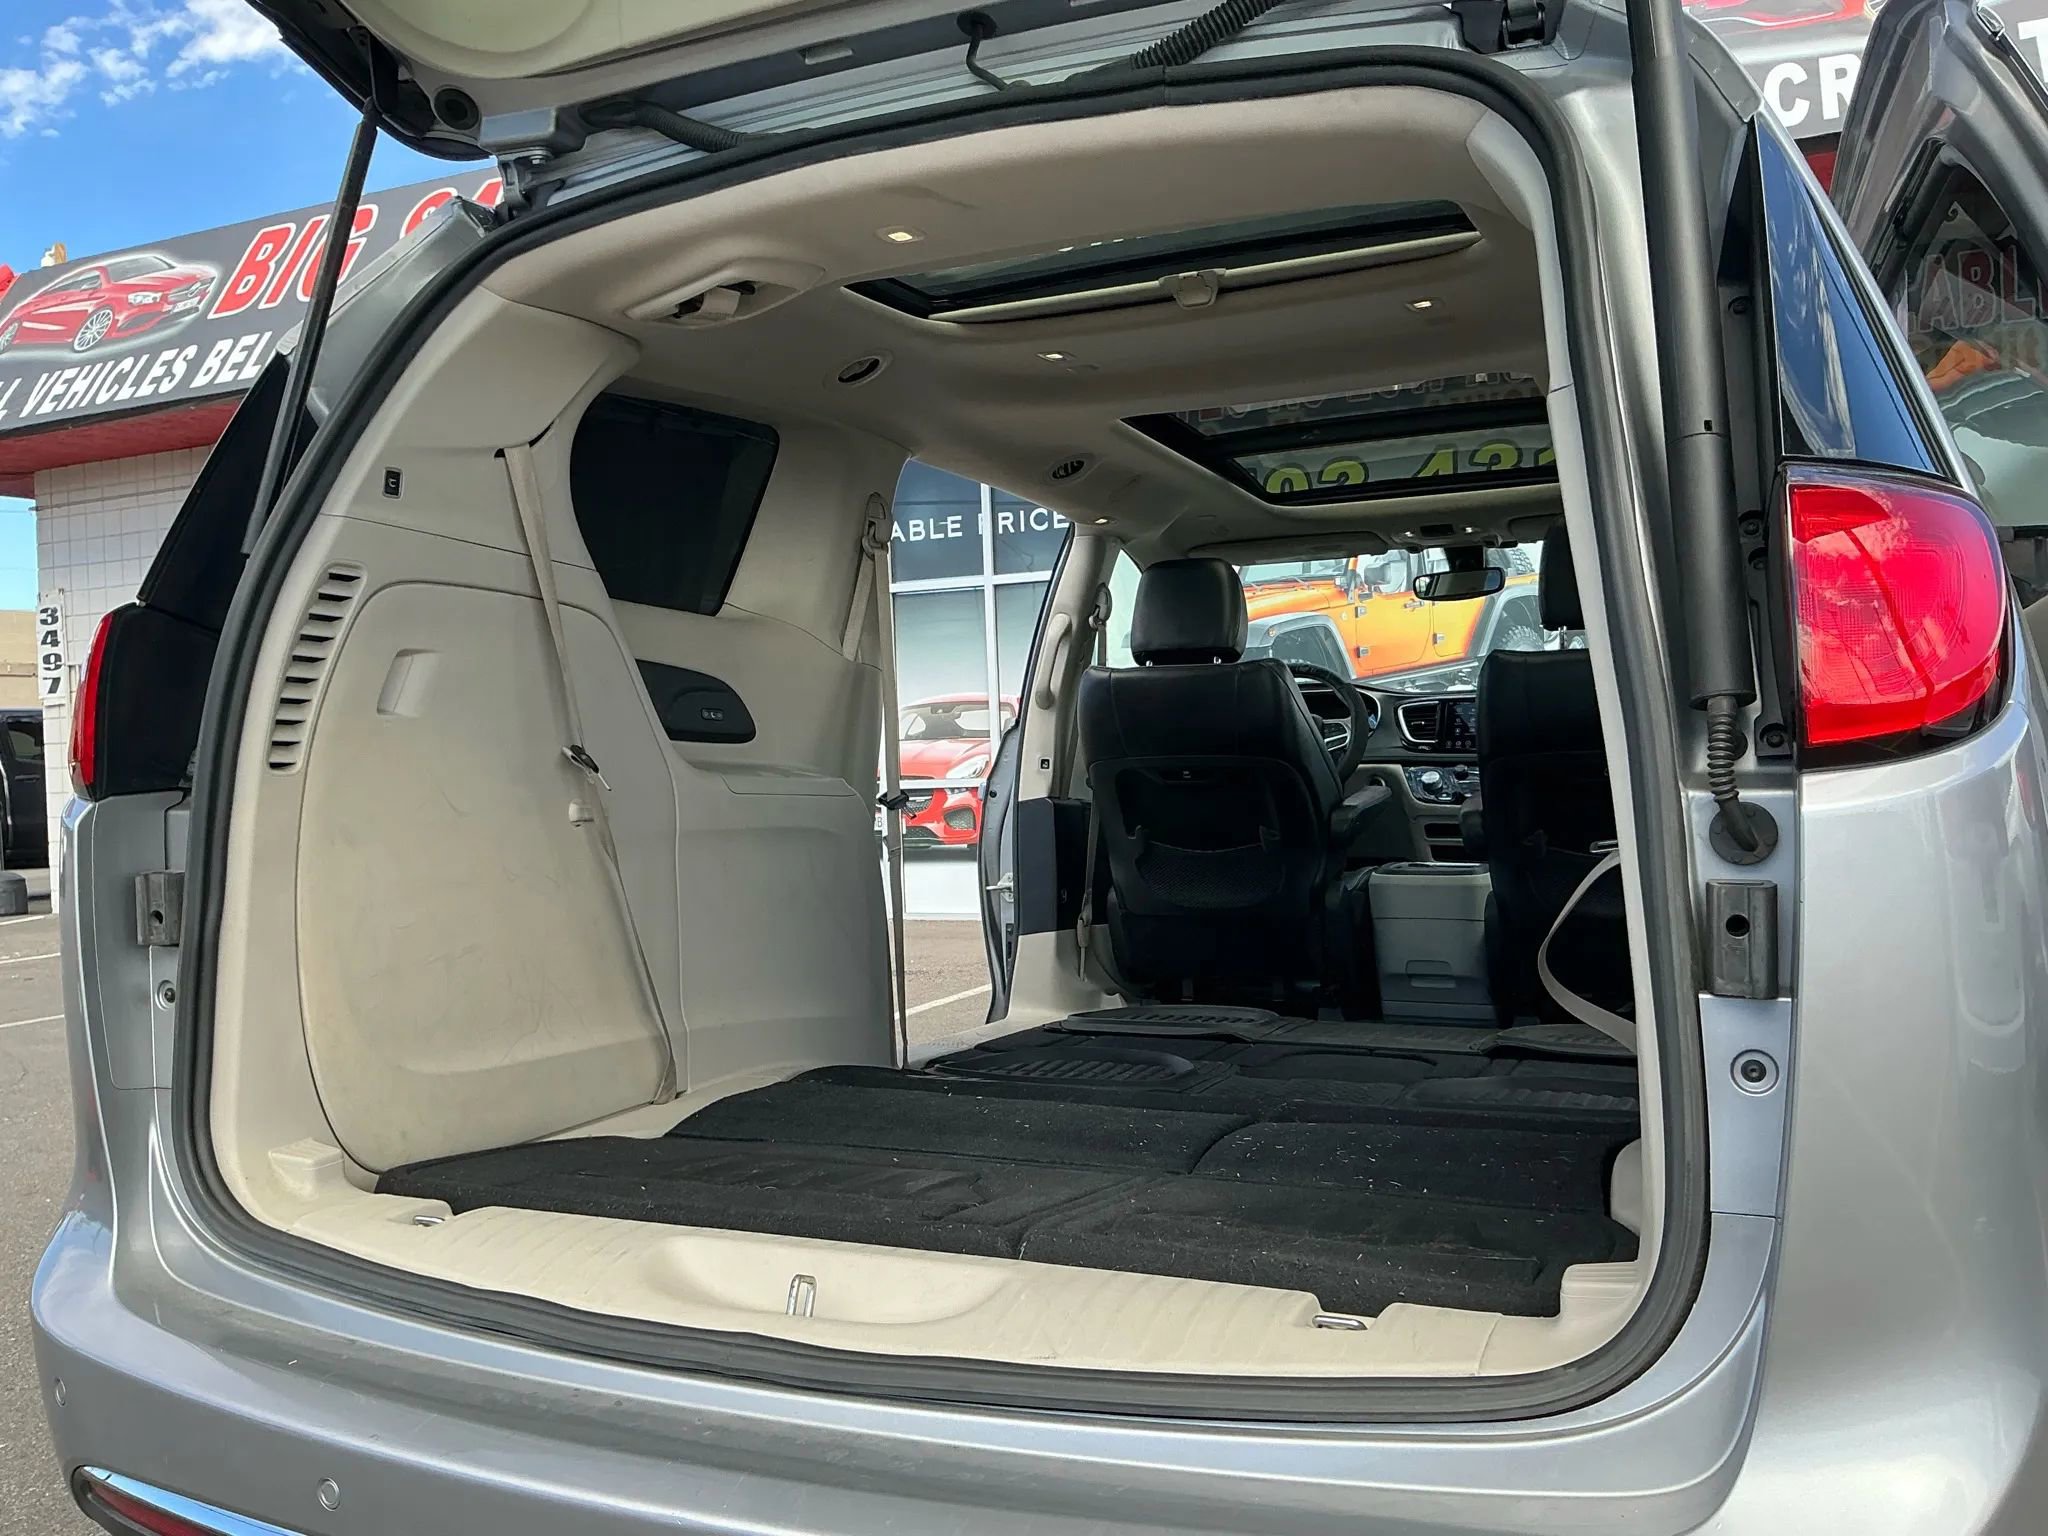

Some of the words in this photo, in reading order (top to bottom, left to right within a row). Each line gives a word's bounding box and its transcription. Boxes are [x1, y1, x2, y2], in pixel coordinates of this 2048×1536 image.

[19, 344, 199, 418] VEHICLES
[189, 330, 277, 388] BEL
[890, 515, 963, 543] ABLE
[39, 606, 62, 695] 3497
